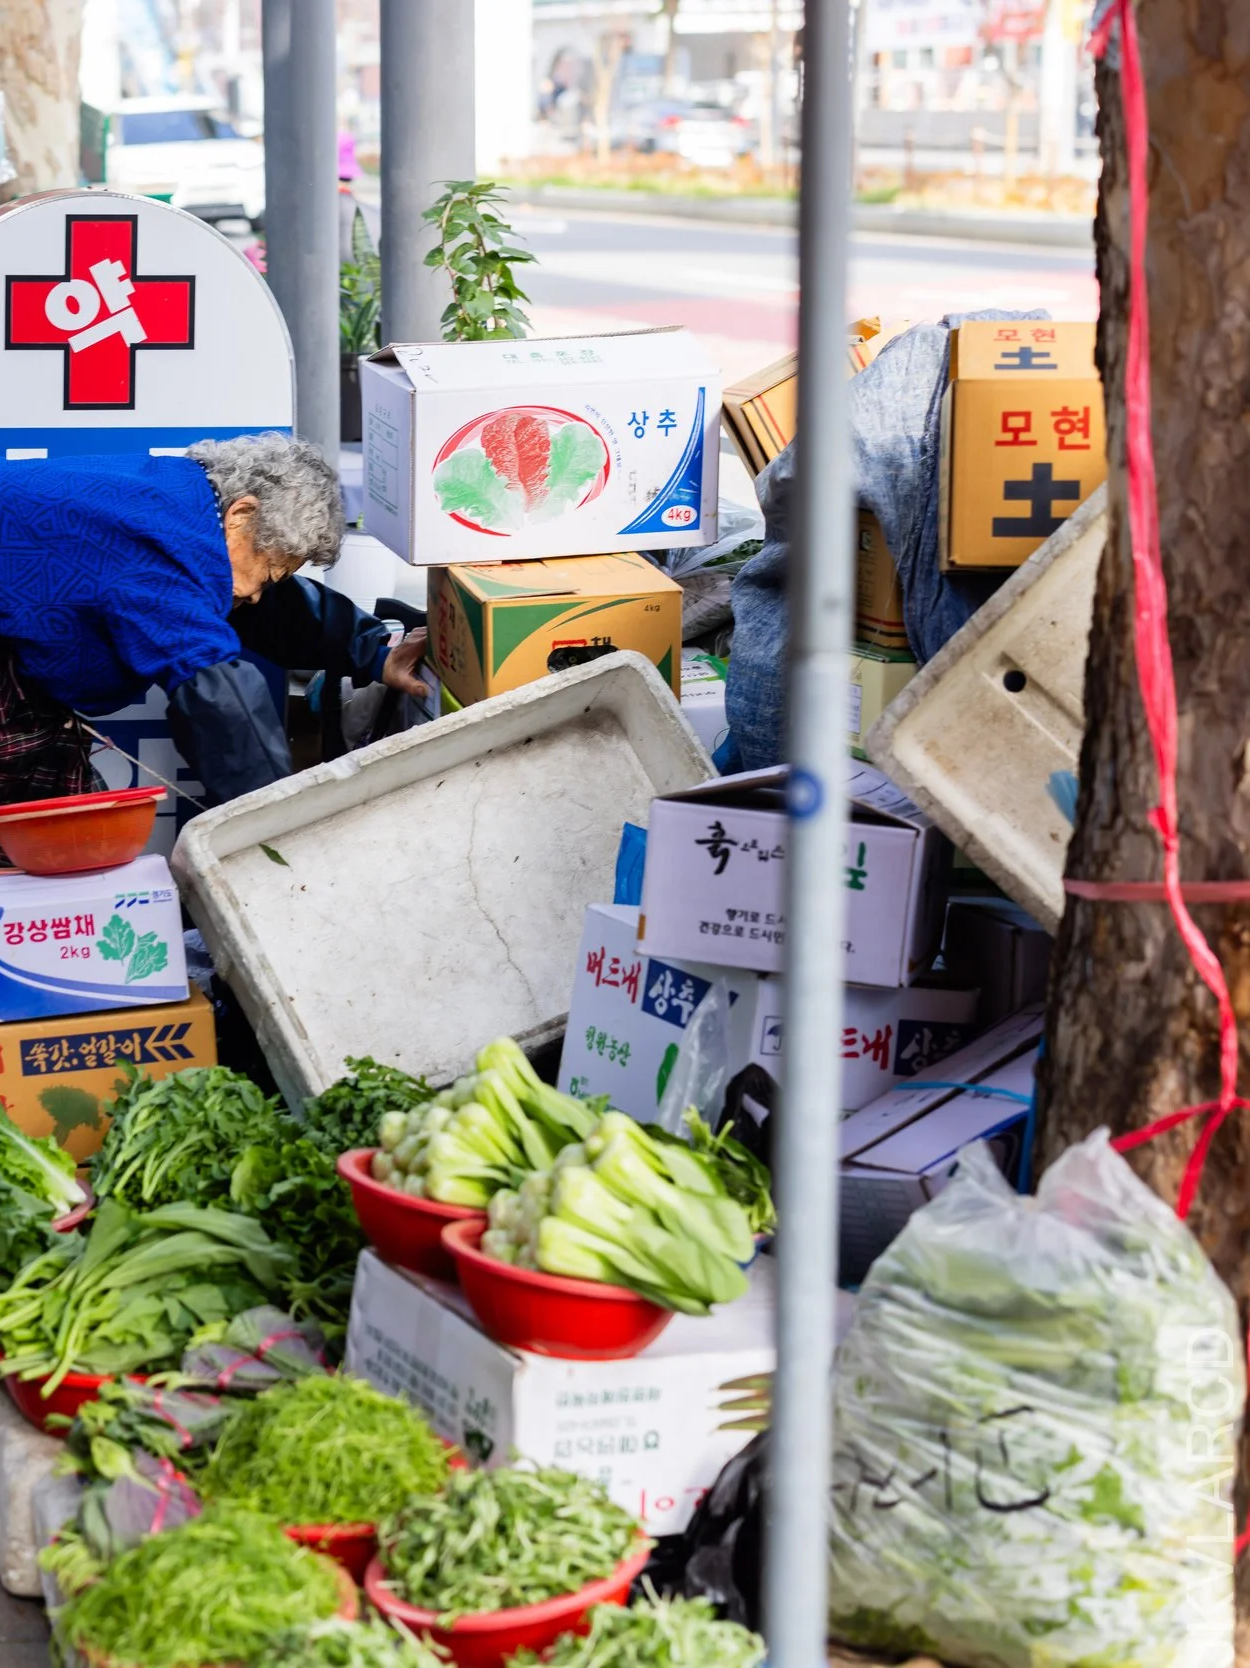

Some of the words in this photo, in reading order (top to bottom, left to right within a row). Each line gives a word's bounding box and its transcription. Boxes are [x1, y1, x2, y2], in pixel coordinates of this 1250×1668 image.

[45, 258, 148, 353] 약
[994, 328, 1056, 343] 모현
[627, 409, 678, 439] 상추
[994, 406, 1091, 451] 모현
[667, 507, 692, 522] 4kg
[643, 603, 661, 613] 4kg
[3, 913, 95, 946] 강상쌈채
[60, 946, 91, 960] 2kg
[649, 970, 695, 1025] 상추
[839, 1024, 892, 1071] 드내
